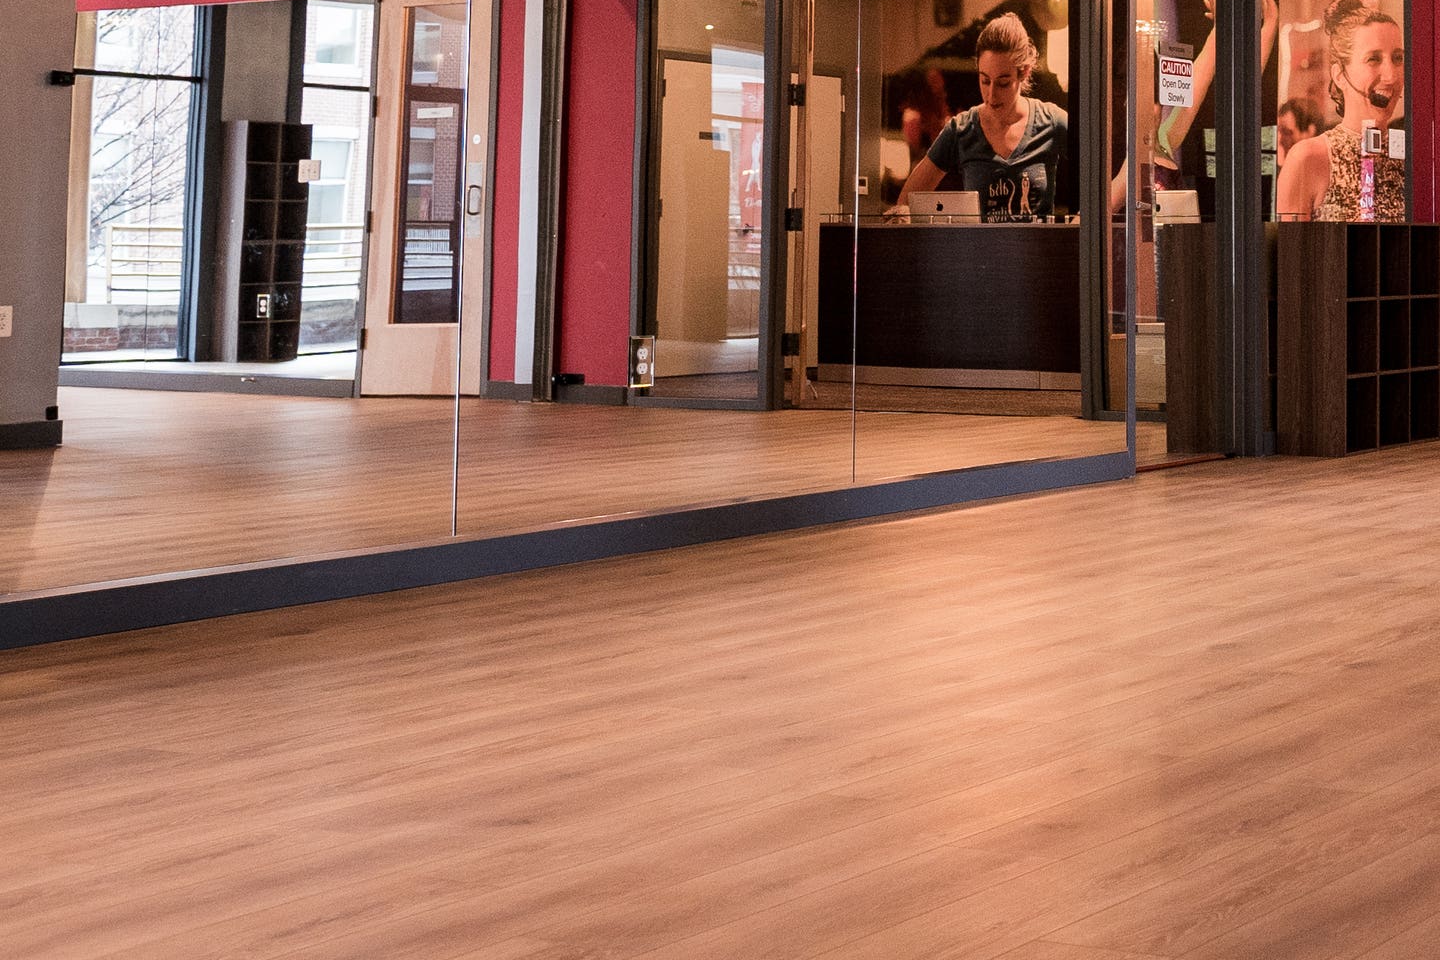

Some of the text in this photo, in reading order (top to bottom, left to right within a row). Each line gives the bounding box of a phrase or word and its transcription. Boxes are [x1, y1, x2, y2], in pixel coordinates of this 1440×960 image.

[1161, 61, 1192, 76] CAUTION
[1161, 78, 1191, 89] Open Door
[1168, 92, 1185, 105] Slowly
